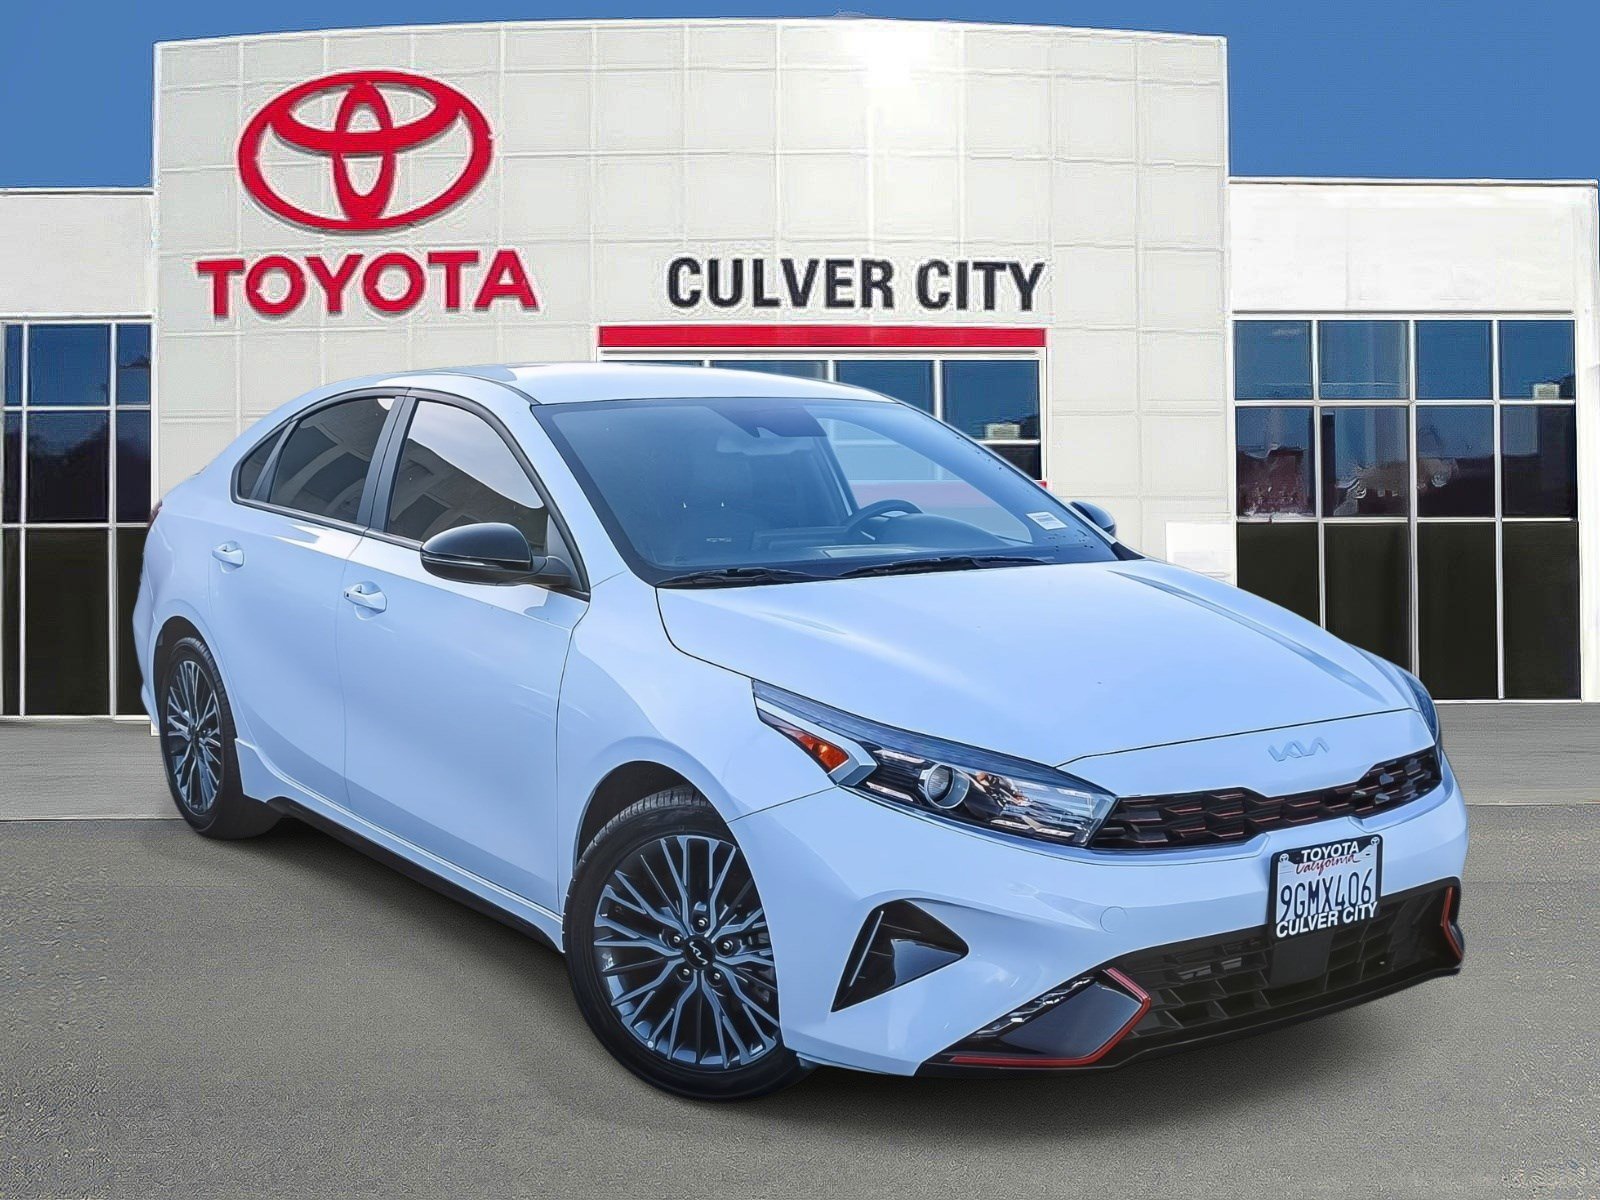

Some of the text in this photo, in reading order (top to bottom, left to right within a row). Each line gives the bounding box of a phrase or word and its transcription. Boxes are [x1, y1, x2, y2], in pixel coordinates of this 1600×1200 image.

[195, 249, 540, 318] TOYOTA
[667, 257, 1046, 311] CULVER CITY
[1296, 853, 1361, 876] California
[1301, 841, 1359, 862] TOYOTA
[1280, 868, 1373, 922] 9GMX406
[1276, 901, 1378, 938] CULVER CITY
